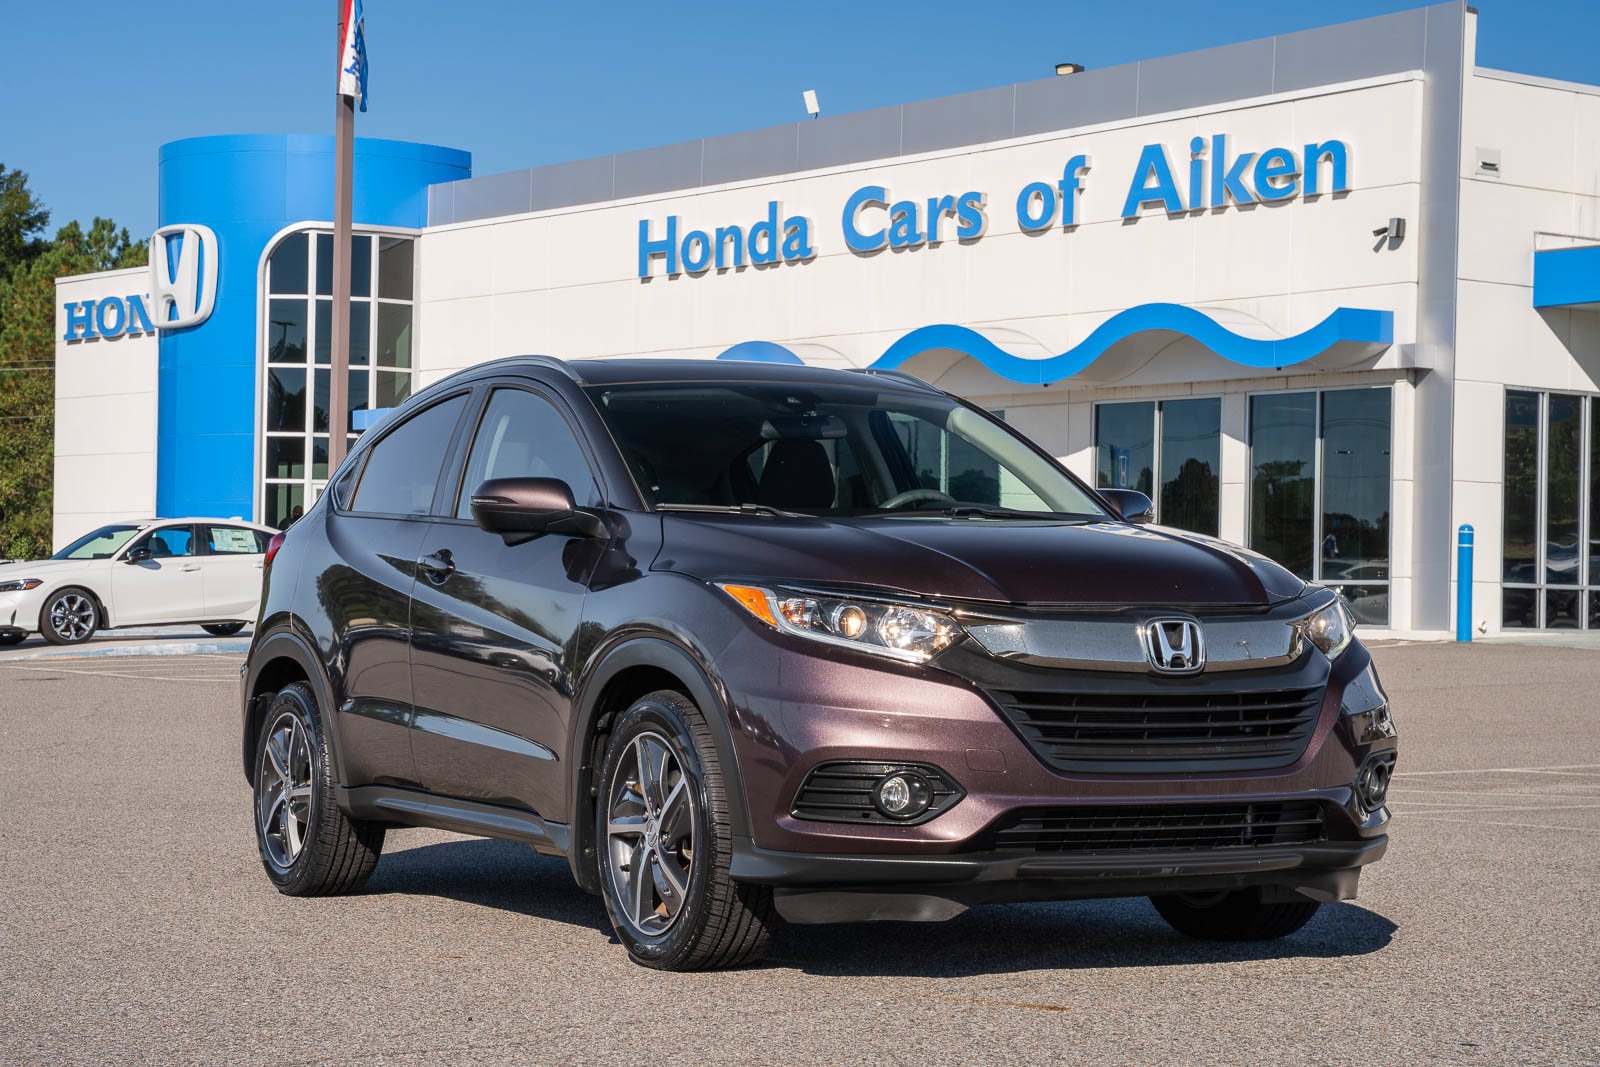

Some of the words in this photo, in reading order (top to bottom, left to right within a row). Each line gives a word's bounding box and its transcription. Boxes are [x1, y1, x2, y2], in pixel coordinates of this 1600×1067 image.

[639, 201, 813, 278] Honda
[842, 186, 983, 251] Cars
[1016, 155, 1087, 230] of
[1121, 133, 1347, 218] Aiken
